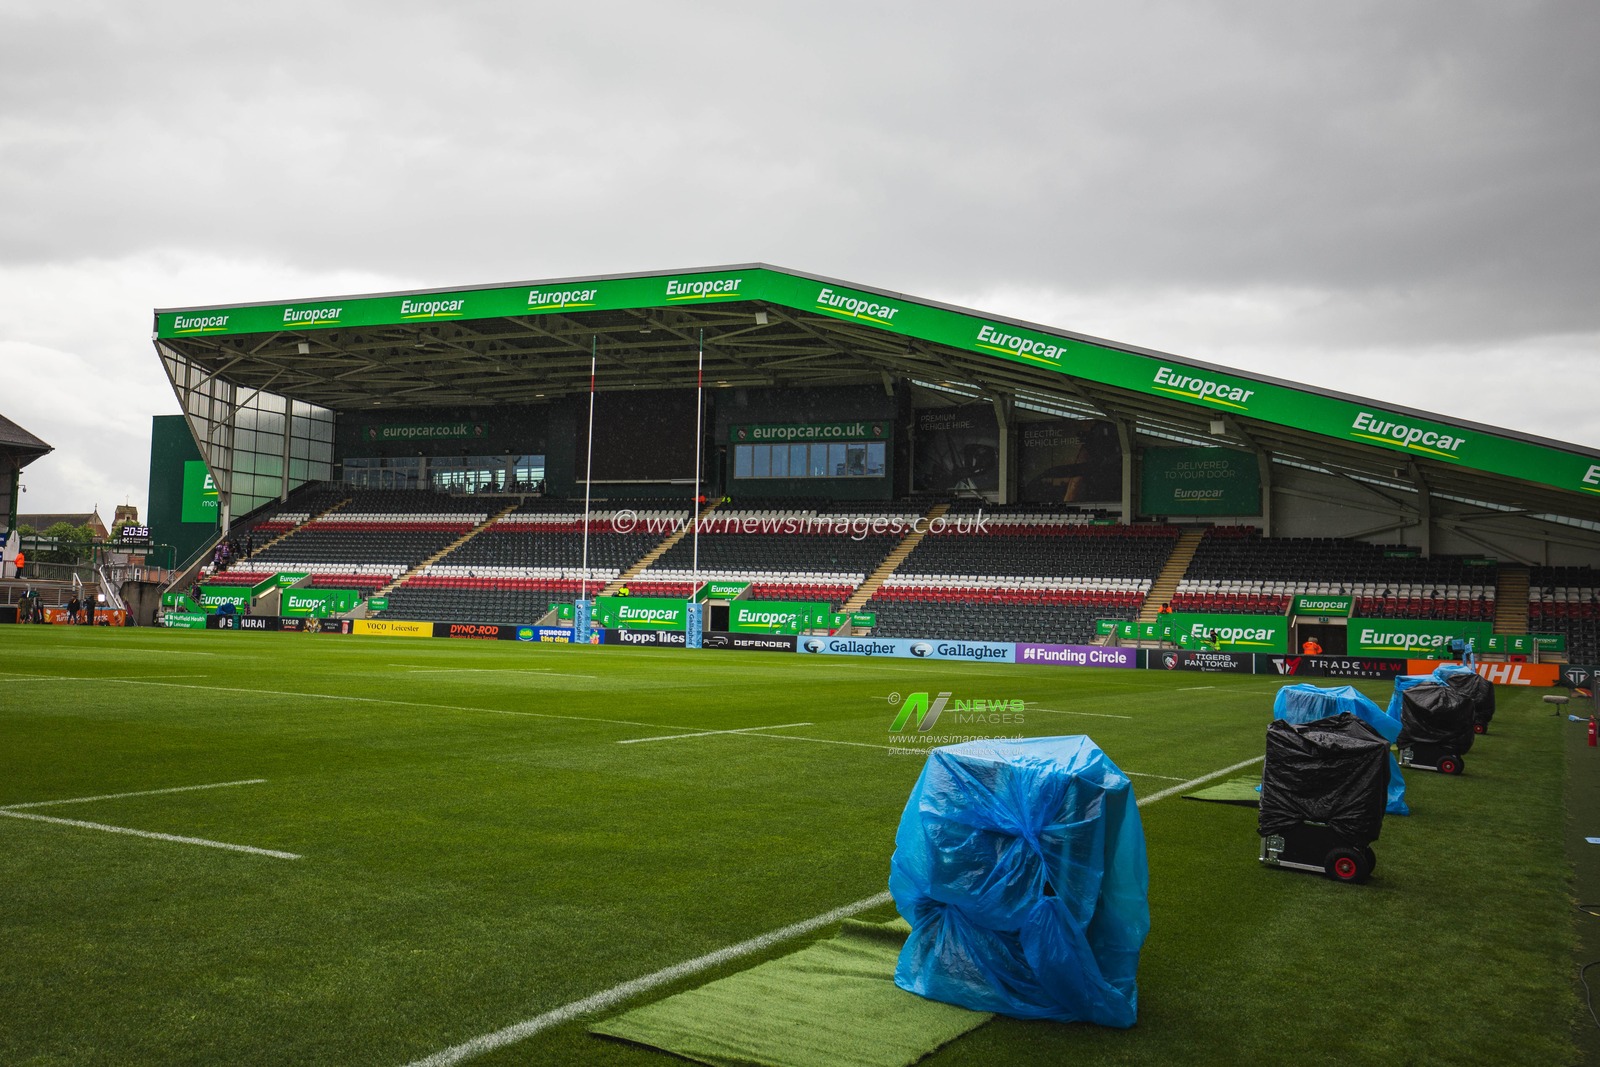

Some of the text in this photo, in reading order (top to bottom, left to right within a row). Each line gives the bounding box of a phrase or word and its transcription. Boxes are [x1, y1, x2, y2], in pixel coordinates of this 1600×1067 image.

[665, 276, 742, 298] Europcar
[527, 287, 597, 308] Europcar
[817, 287, 899, 320] Europcar
[401, 298, 464, 316] Europcar
[283, 306, 342, 324] Europcar
[173, 314, 229, 331] Europcar
[976, 325, 1067, 361] Europcar
[1153, 366, 1254, 403] Europcar
[920, 414, 956, 423] PREMIUM
[383, 424, 467, 438] europcar.co.uk
[753, 423, 865, 440] europcar.co.uk
[920, 421, 951, 431] VEHICLE
[1351, 411, 1466, 452] Europcar
[1024, 429, 1063, 439] ELECTRIC
[1024, 438, 1059, 447] VEHICLE
[1179, 471, 1205, 479] YOUR
[1207, 470, 1236, 479] DOOR
[1174, 488, 1224, 500] Europcar
[123, 527, 149, 536] 20:36
[1299, 599, 1348, 610] Europcar
[618, 606, 679, 623] Europcar
[391, 624, 420, 632] Leicester
[450, 624, 499, 635] DYNO-ROD
[539, 629, 571, 637] squeeze
[1190, 624, 1275, 644] Europcar
[618, 630, 685, 643] Topps Tiles
[734, 640, 791, 649] DEFENDER
[829, 640, 895, 655] Gallagher
[937, 646, 1007, 660] Gallagher
[1036, 648, 1127, 666] Funding Circle
